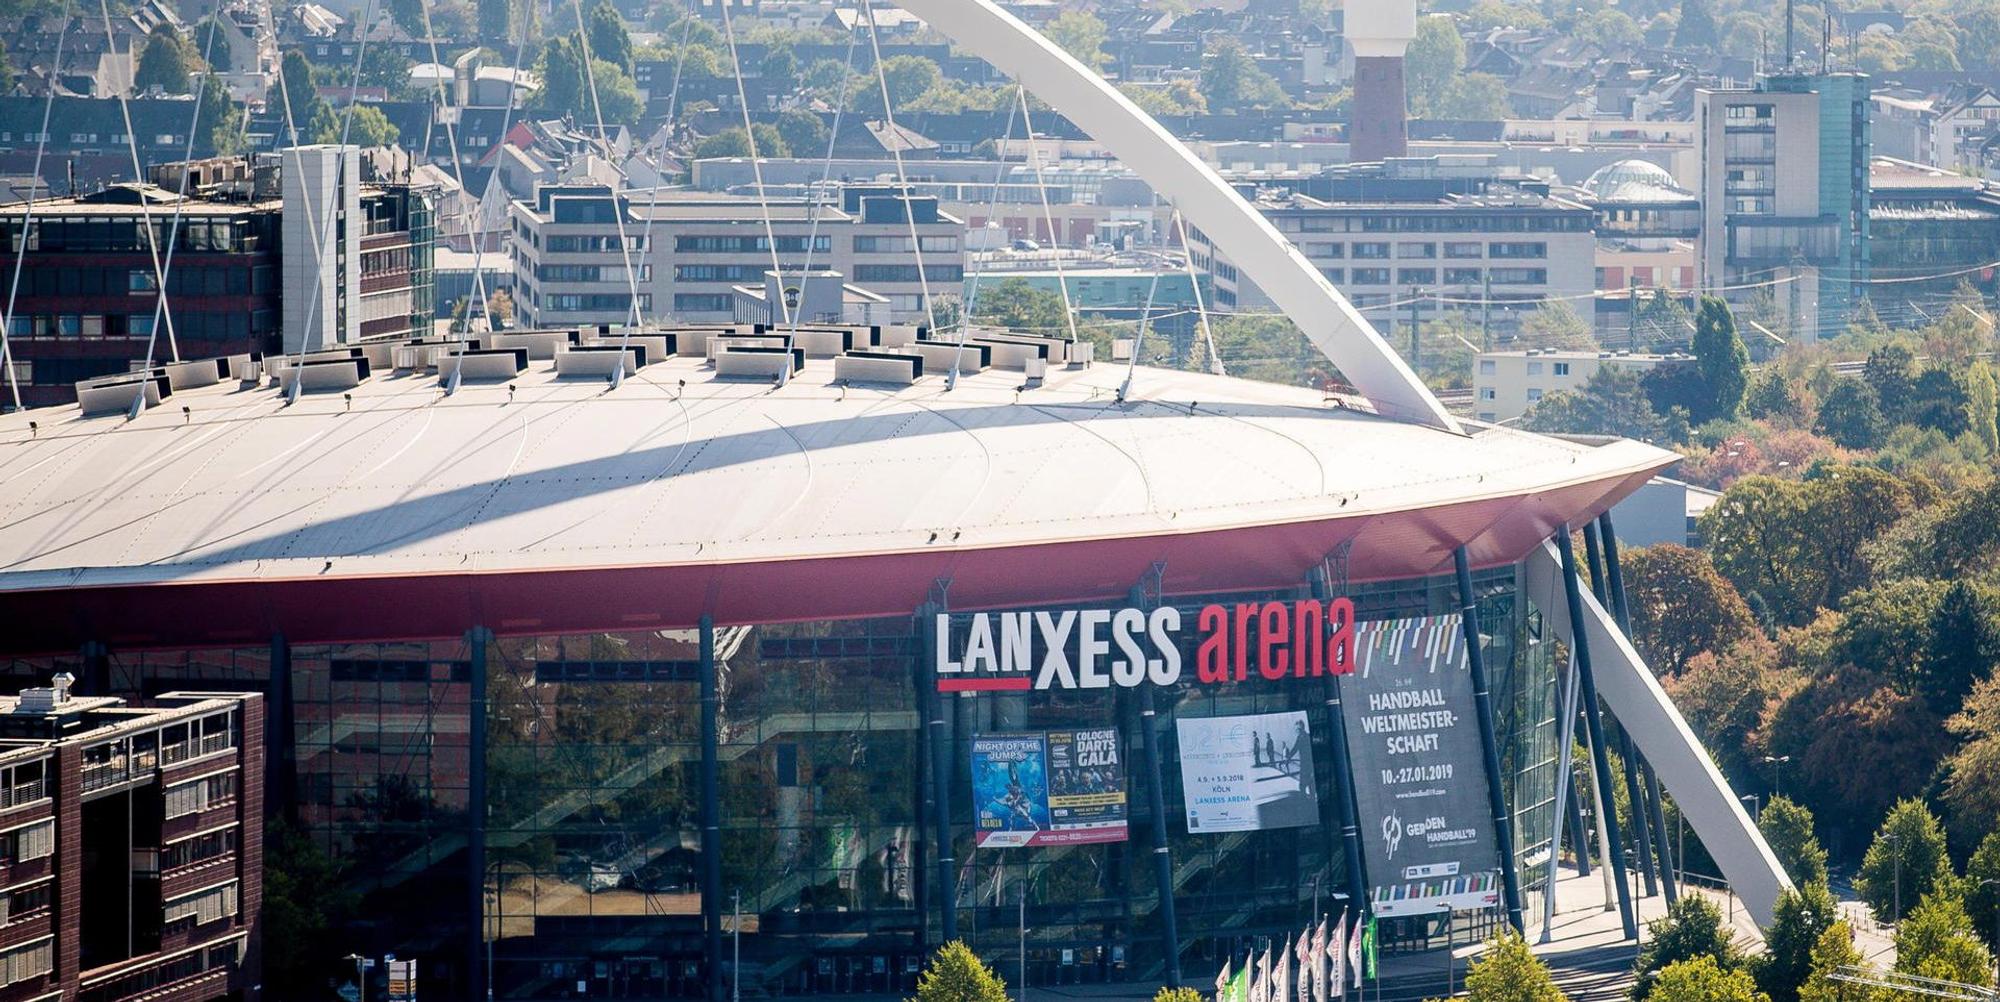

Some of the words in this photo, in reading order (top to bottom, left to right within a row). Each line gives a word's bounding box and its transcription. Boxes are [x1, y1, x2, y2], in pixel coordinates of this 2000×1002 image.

[937, 606, 1181, 690] LANXESS
[1196, 597, 1355, 683] arena
[1369, 688, 1446, 711] HANDBALL
[1360, 710, 1458, 734] WELTMEISTER-
[1076, 730, 1115, 741] COLOGNE
[976, 742, 1003, 751] NIGHT
[1006, 742, 1017, 751] OF
[1020, 742, 1039, 751] THE
[1077, 739, 1116, 753] DARTS
[1386, 733, 1439, 755] SCHAFT
[990, 751, 1023, 760] JUMPS
[1078, 750, 1118, 767] GALA
[1381, 764, 1453, 785] 10.-27.01.2019
[1212, 785, 1231, 793] KÖLN
[1195, 796, 1225, 805] LANXESS
[1227, 795, 1251, 803] ARENA
